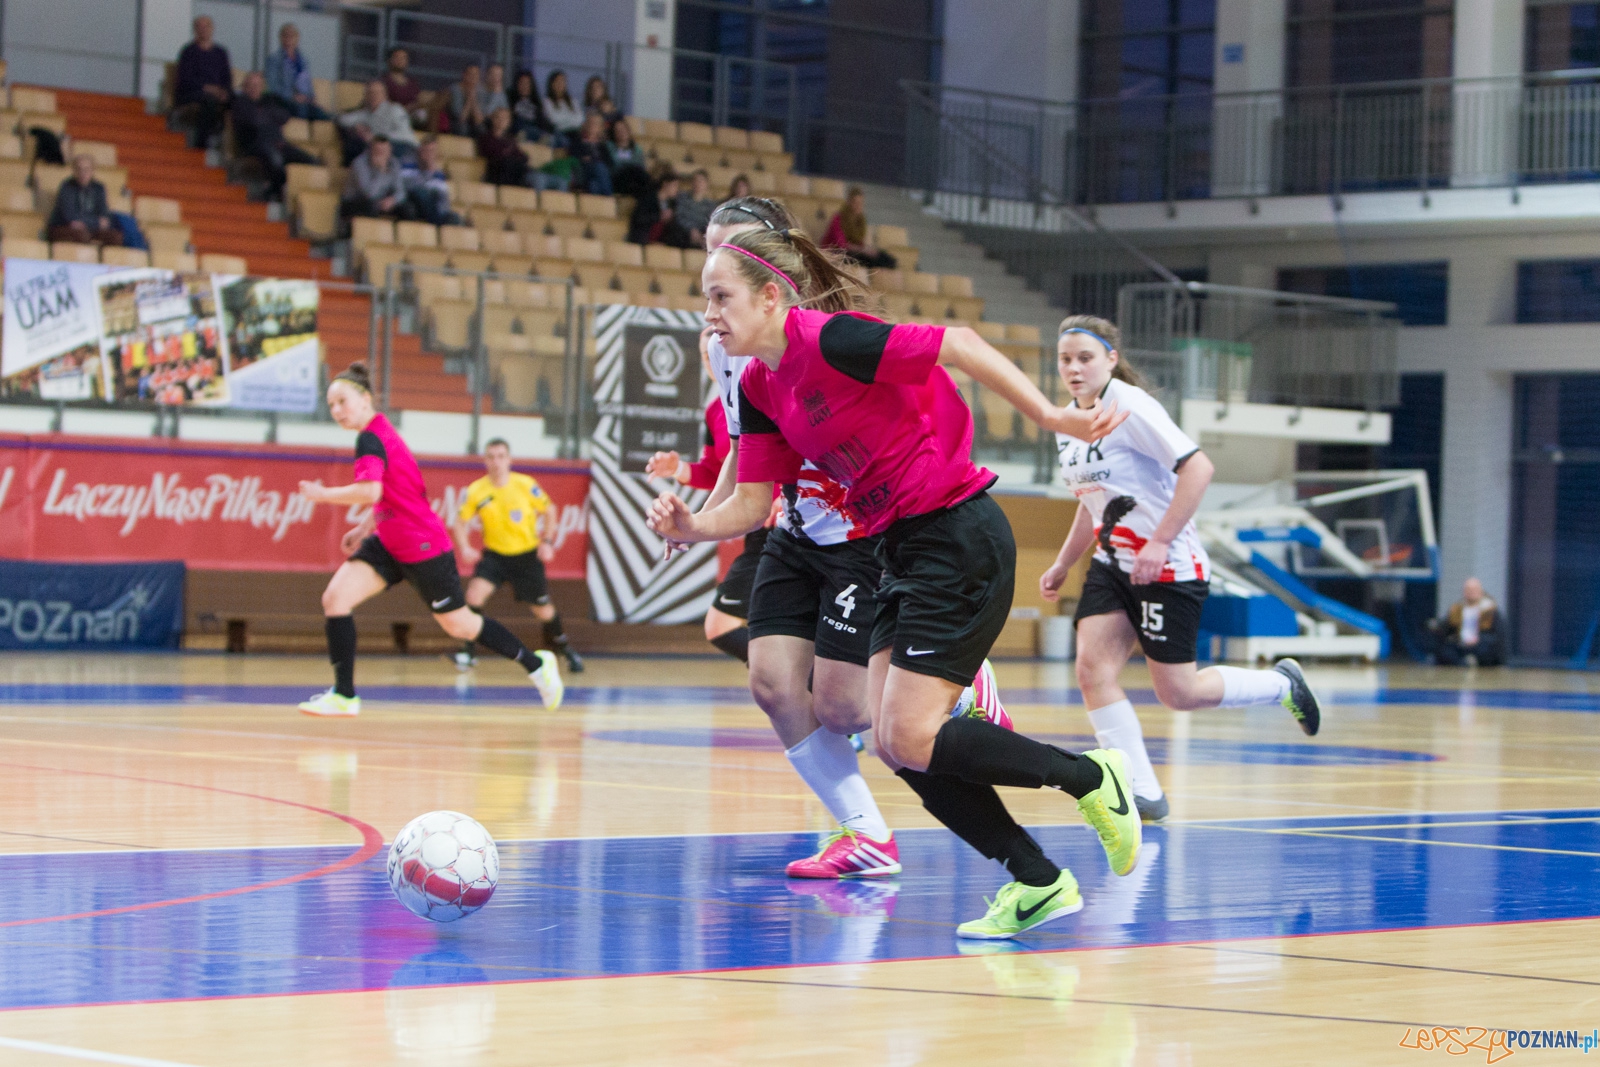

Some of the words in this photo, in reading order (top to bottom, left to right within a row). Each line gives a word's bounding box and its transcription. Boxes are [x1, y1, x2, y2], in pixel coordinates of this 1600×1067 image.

[14, 286, 80, 330] UAM
[846, 482, 891, 515] MEX
[834, 583, 859, 619] 4
[1140, 600, 1164, 632] 15
[822, 615, 857, 634] regio
